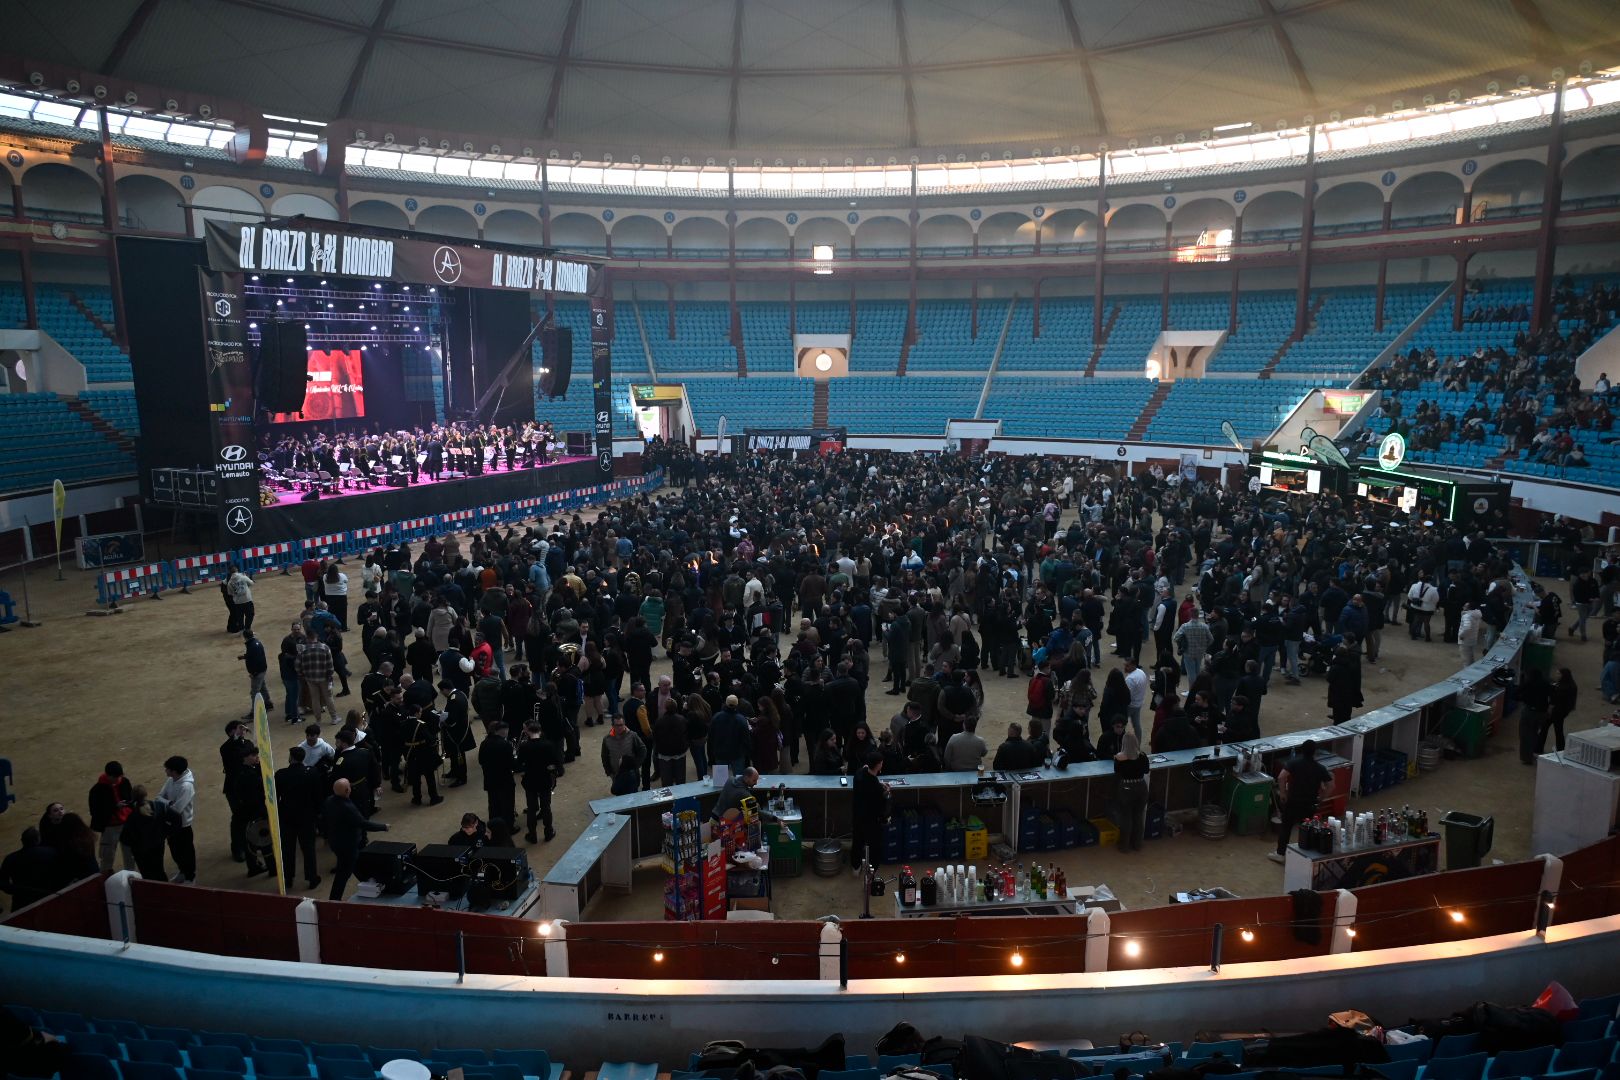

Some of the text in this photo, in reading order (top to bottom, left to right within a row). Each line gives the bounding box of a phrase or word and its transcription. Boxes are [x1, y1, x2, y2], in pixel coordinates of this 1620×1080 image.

[239, 226, 394, 278] AL BRAZO Y AL HOMBRO
[492, 253, 503, 287] AL
[505, 254, 535, 289] BRAZO
[542, 258, 553, 291] AL
[555, 260, 589, 294] HOMBRO
[215, 462, 254, 472] HYUNDAI
[221, 471, 250, 479] Lemauto
